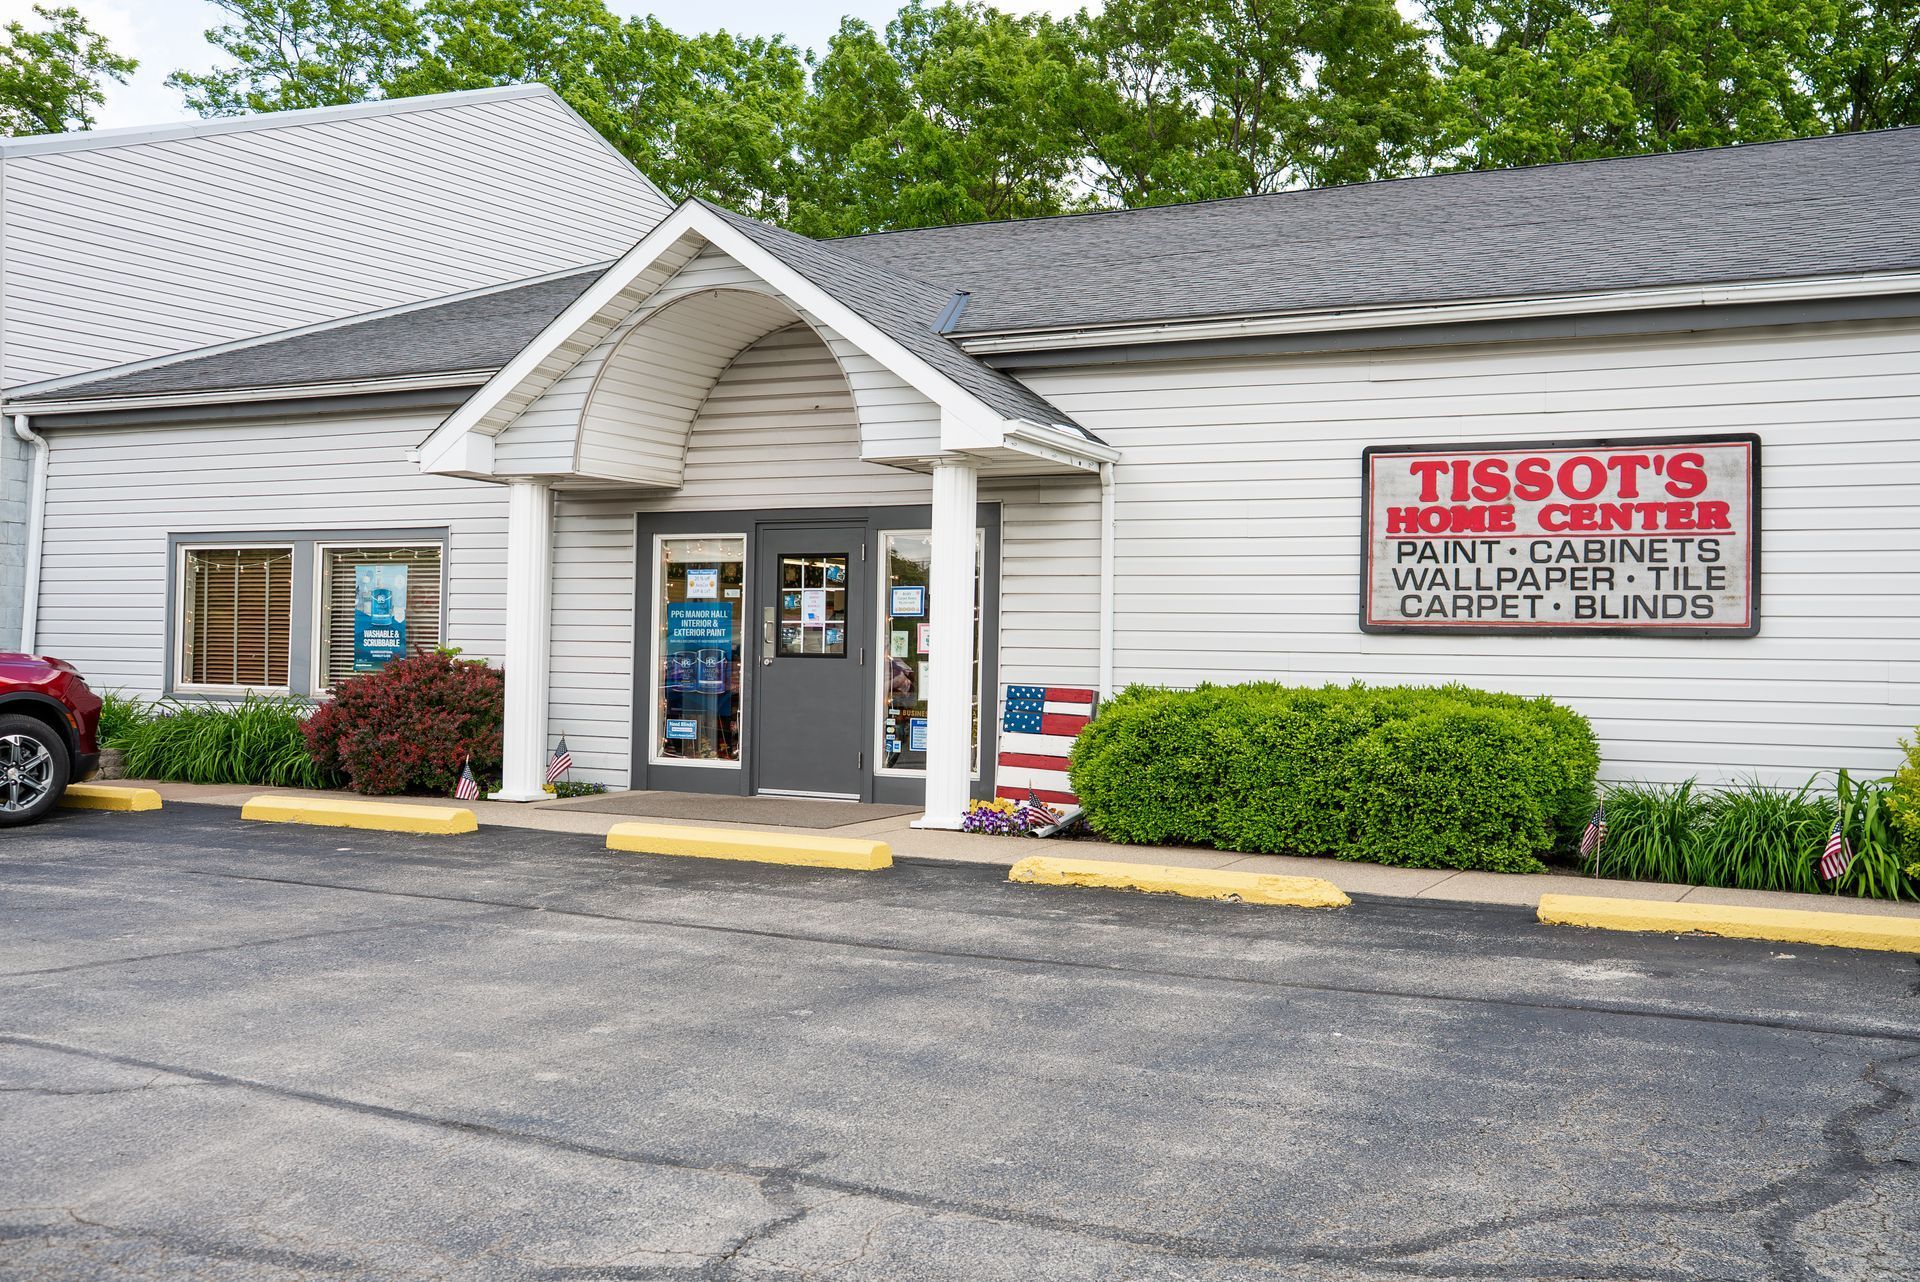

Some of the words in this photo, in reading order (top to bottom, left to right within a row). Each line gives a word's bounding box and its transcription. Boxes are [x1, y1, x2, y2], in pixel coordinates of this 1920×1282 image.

[1410, 452, 1708, 503] TISSOT'S
[1385, 504, 1516, 533] HOME
[1537, 501, 1732, 532] CENTER
[1397, 540, 1501, 565] PAINT
[1529, 538, 1721, 564] CABINETS
[1392, 567, 1615, 592] WALLPAPER
[1647, 566, 1726, 591] TILE
[671, 610, 684, 618] PPG
[685, 610, 709, 618] MANOR
[711, 610, 728, 618] HALL
[1400, 594, 1544, 619] CARPET
[1574, 594, 1715, 620] BLINDS
[681, 619, 712, 628] INTERIOR
[712, 619, 719, 628] &
[363, 629, 394, 638] WASHABLE
[394, 630, 400, 638] &
[673, 628, 706, 637] EXTERIOR
[706, 628, 726, 637] PAINT
[363, 639, 400, 647] SCRUBBABLE
